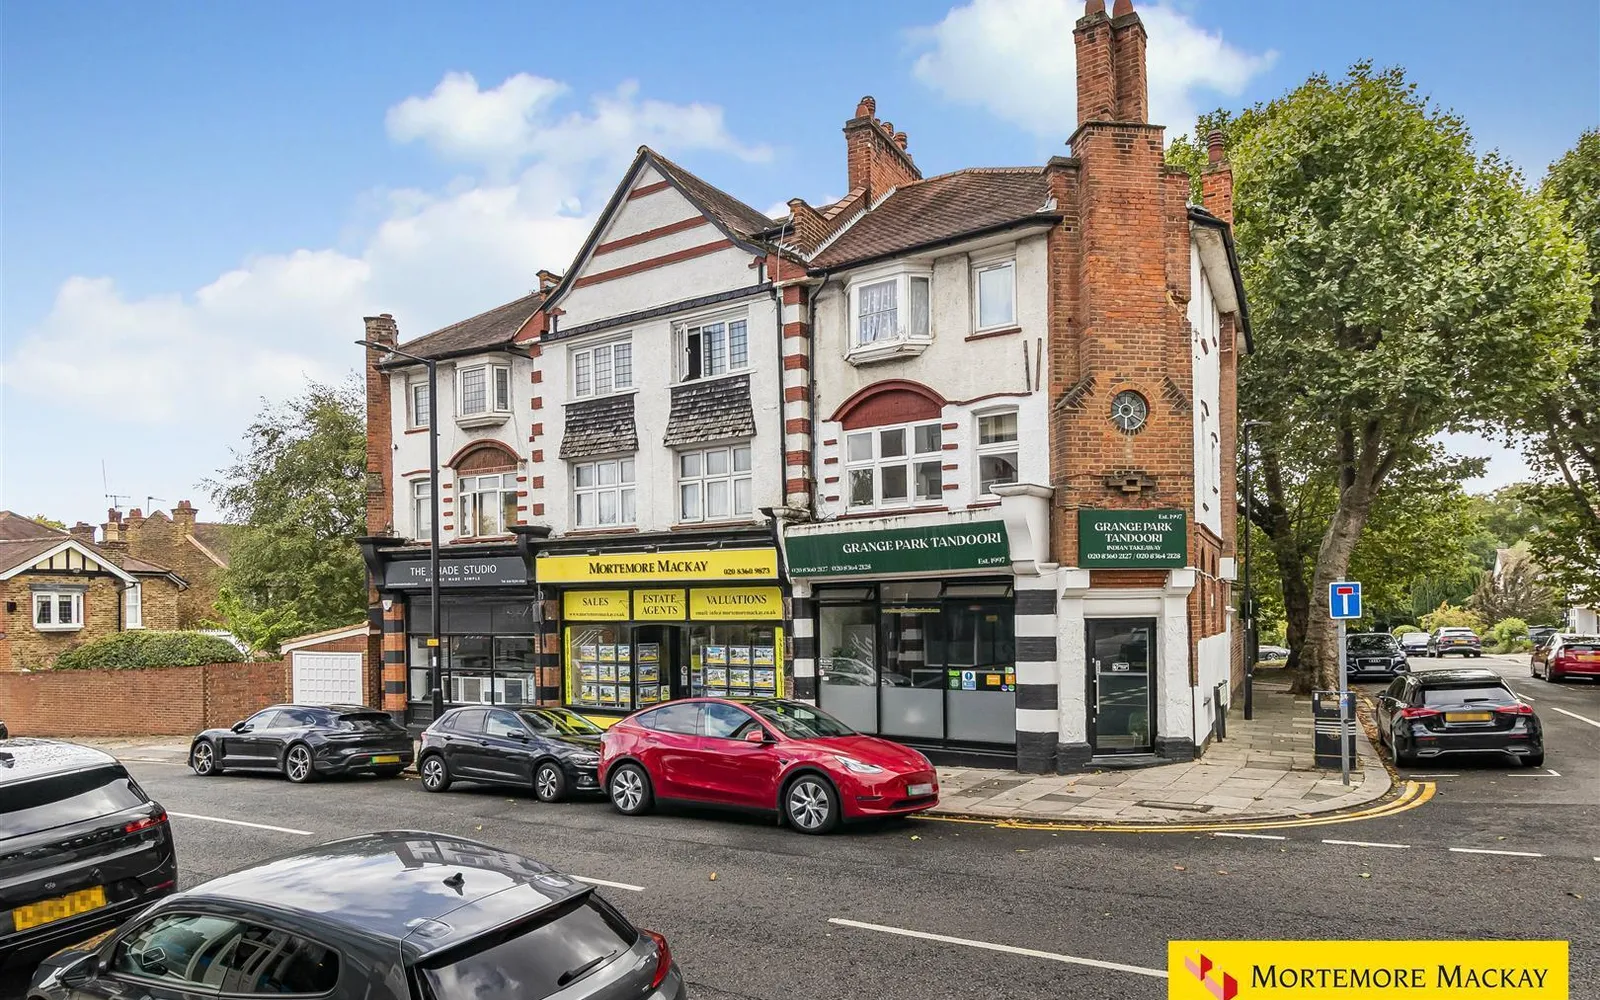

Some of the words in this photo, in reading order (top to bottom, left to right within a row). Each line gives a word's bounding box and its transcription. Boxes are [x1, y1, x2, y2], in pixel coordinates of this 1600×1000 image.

[1094, 522, 1142, 532] GRANGE
[1144, 522, 1172, 532] PARK
[842, 540, 894, 554] GRANGE
[895, 537, 928, 550] PARK
[928, 532, 1002, 548] TANDOORI
[1105, 533, 1163, 543] TANDOORI
[977, 557, 990, 566] Est.
[990, 556, 1006, 565] 1997
[1087, 552, 1101, 560] 020
[1101, 552, 1118, 560] 8360
[1118, 552, 1132, 560] 2127
[1136, 552, 1149, 560] 020
[1166, 552, 1181, 560] 2128
[410, 566, 426, 576] THE
[463, 564, 497, 575] STUDIO
[589, 562, 655, 574] MORTEMORE
[657, 559, 708, 573] MACKAY
[723, 568, 736, 576] 020
[737, 567, 753, 575] 8360
[754, 567, 770, 575] 9873
[582, 597, 609, 607] SALES
[642, 593, 677, 604] ESTATE
[706, 594, 767, 605] VALUATIONS
[641, 605, 678, 615] AGENTS
